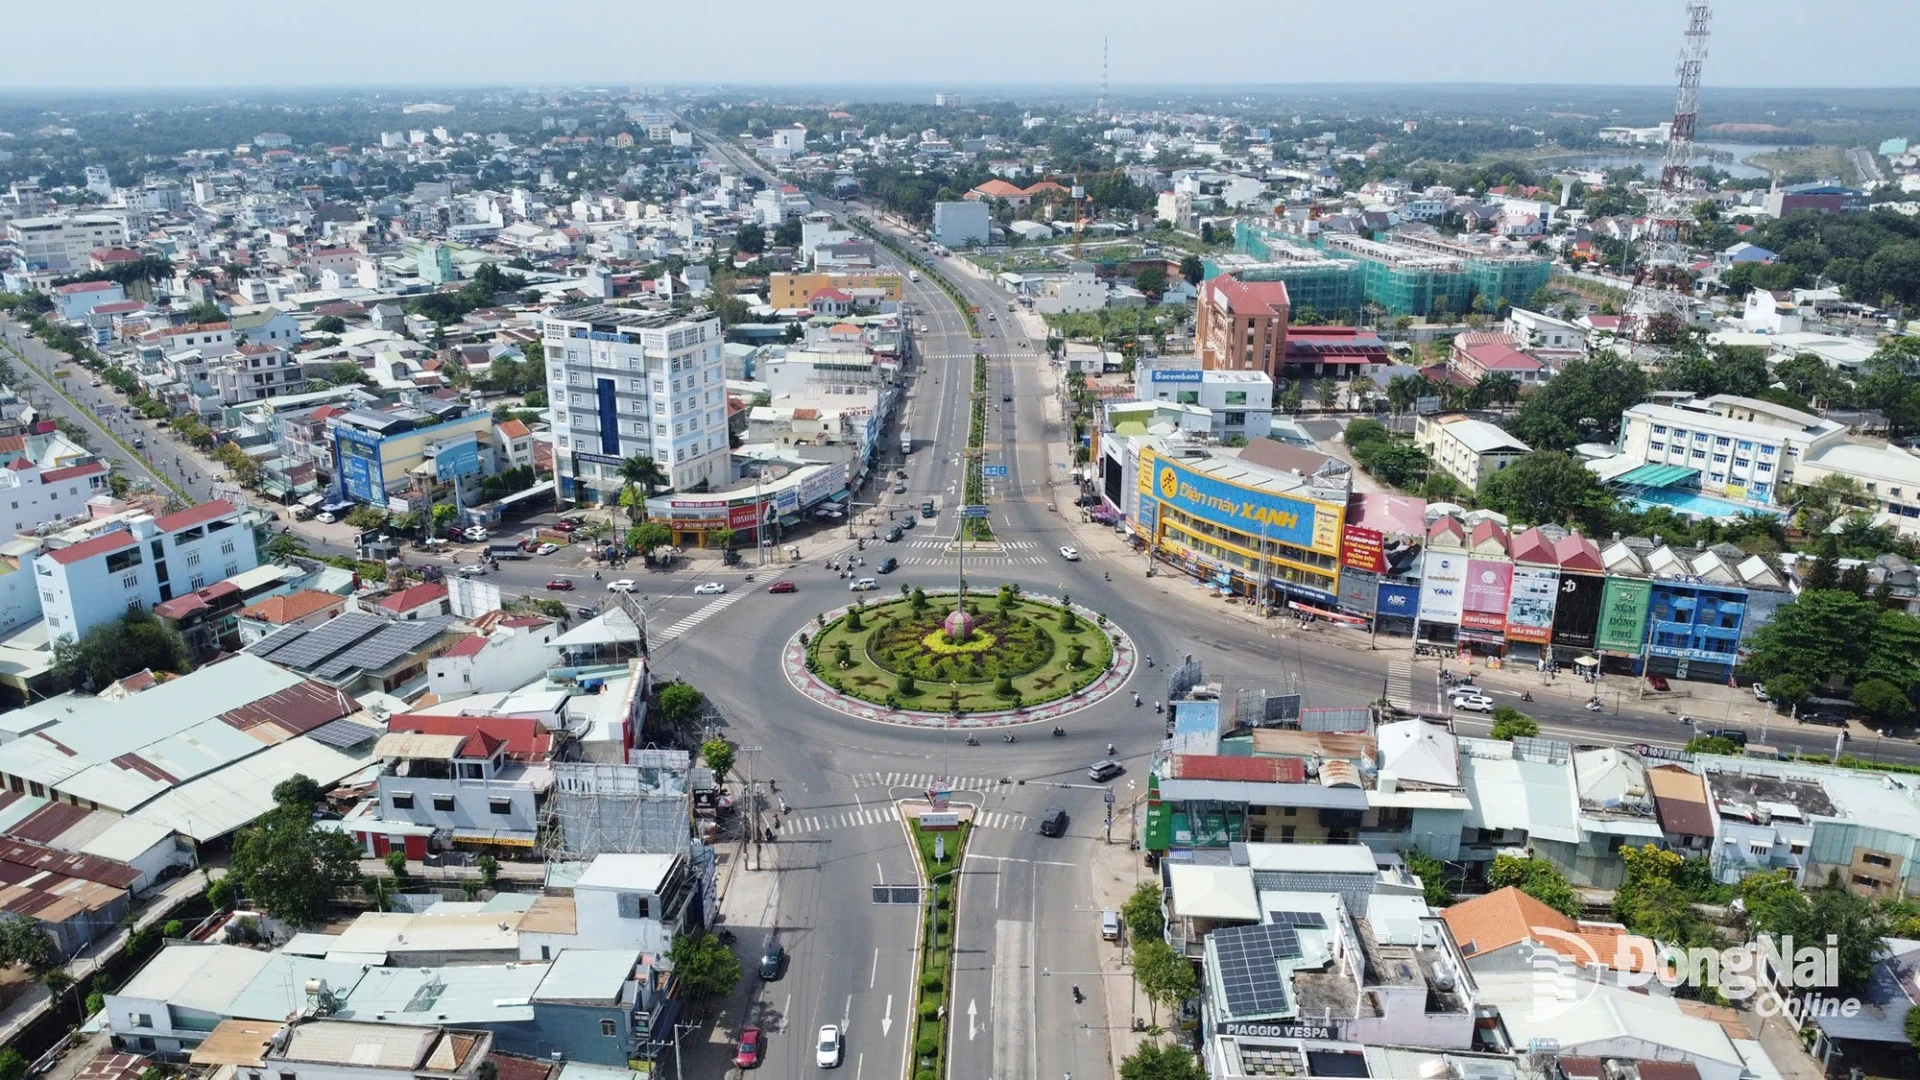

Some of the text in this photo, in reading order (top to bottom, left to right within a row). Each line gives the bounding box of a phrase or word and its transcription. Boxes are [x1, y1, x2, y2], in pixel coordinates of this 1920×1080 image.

[1155, 371, 1201, 381] Sacombank
[1179, 481, 1206, 505] Điện
[1207, 496, 1240, 518] máy
[1240, 501, 1299, 530] XANH
[1433, 587, 1453, 596] YAN
[1387, 595, 1406, 603] ABC
[1226, 1024, 1329, 1038] PIAGGIO VESPA
